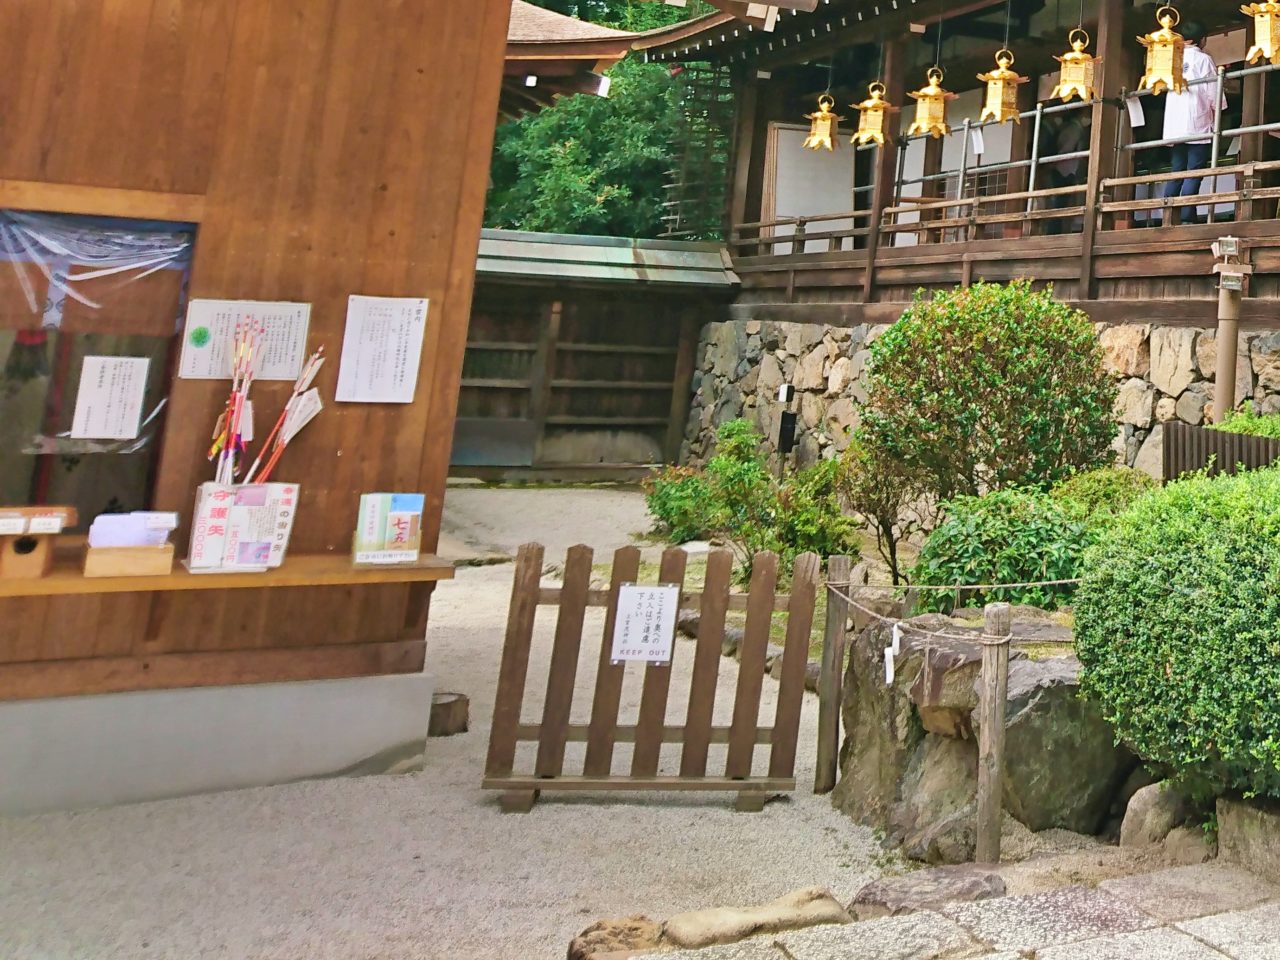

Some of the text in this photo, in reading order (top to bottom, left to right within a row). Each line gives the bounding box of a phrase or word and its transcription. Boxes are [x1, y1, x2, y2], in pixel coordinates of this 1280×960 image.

[207, 489, 231, 537] 守護矢
[635, 592, 645, 617] 下さい
[641, 592, 656, 644] 立入はご遠慮
[652, 592, 665, 645] ここより奥への
